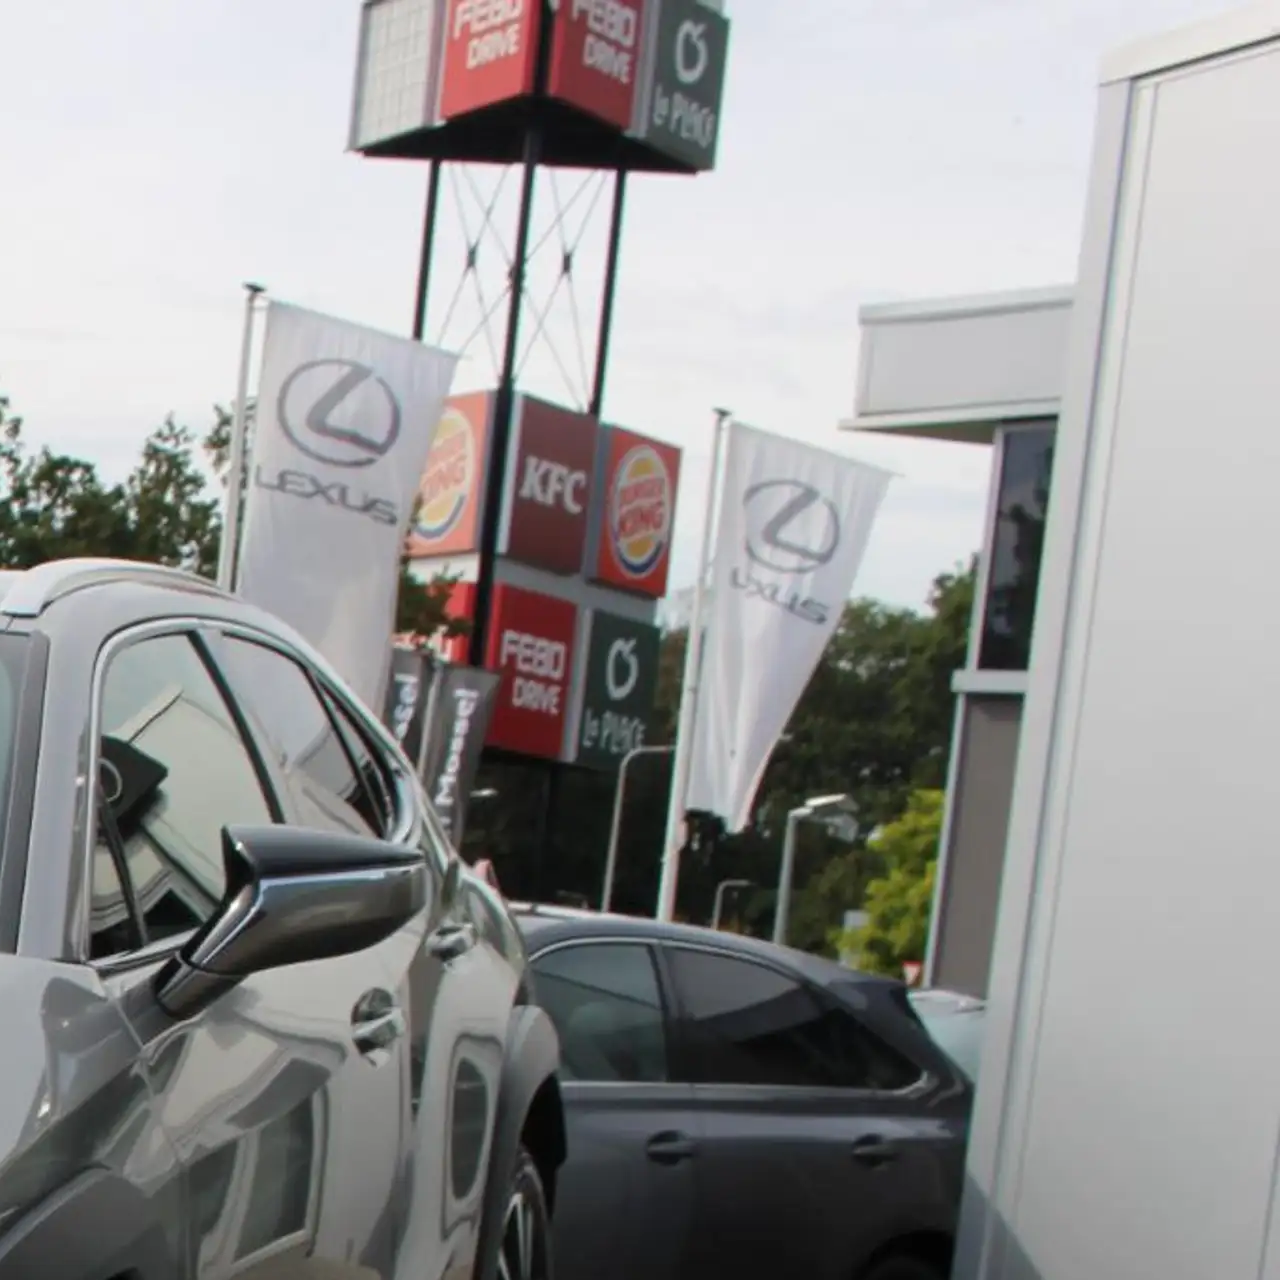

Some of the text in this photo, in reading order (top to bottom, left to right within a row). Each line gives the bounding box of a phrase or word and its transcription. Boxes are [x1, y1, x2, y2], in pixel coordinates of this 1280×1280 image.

[466, 23, 521, 70] DRIVE
[583, 33, 631, 84] DRIVE
[255, 464, 399, 526] LEXUS
[519, 454, 587, 515] KFC
[500, 629, 568, 681] FEBO
[511, 676, 561, 716] DRIVE
